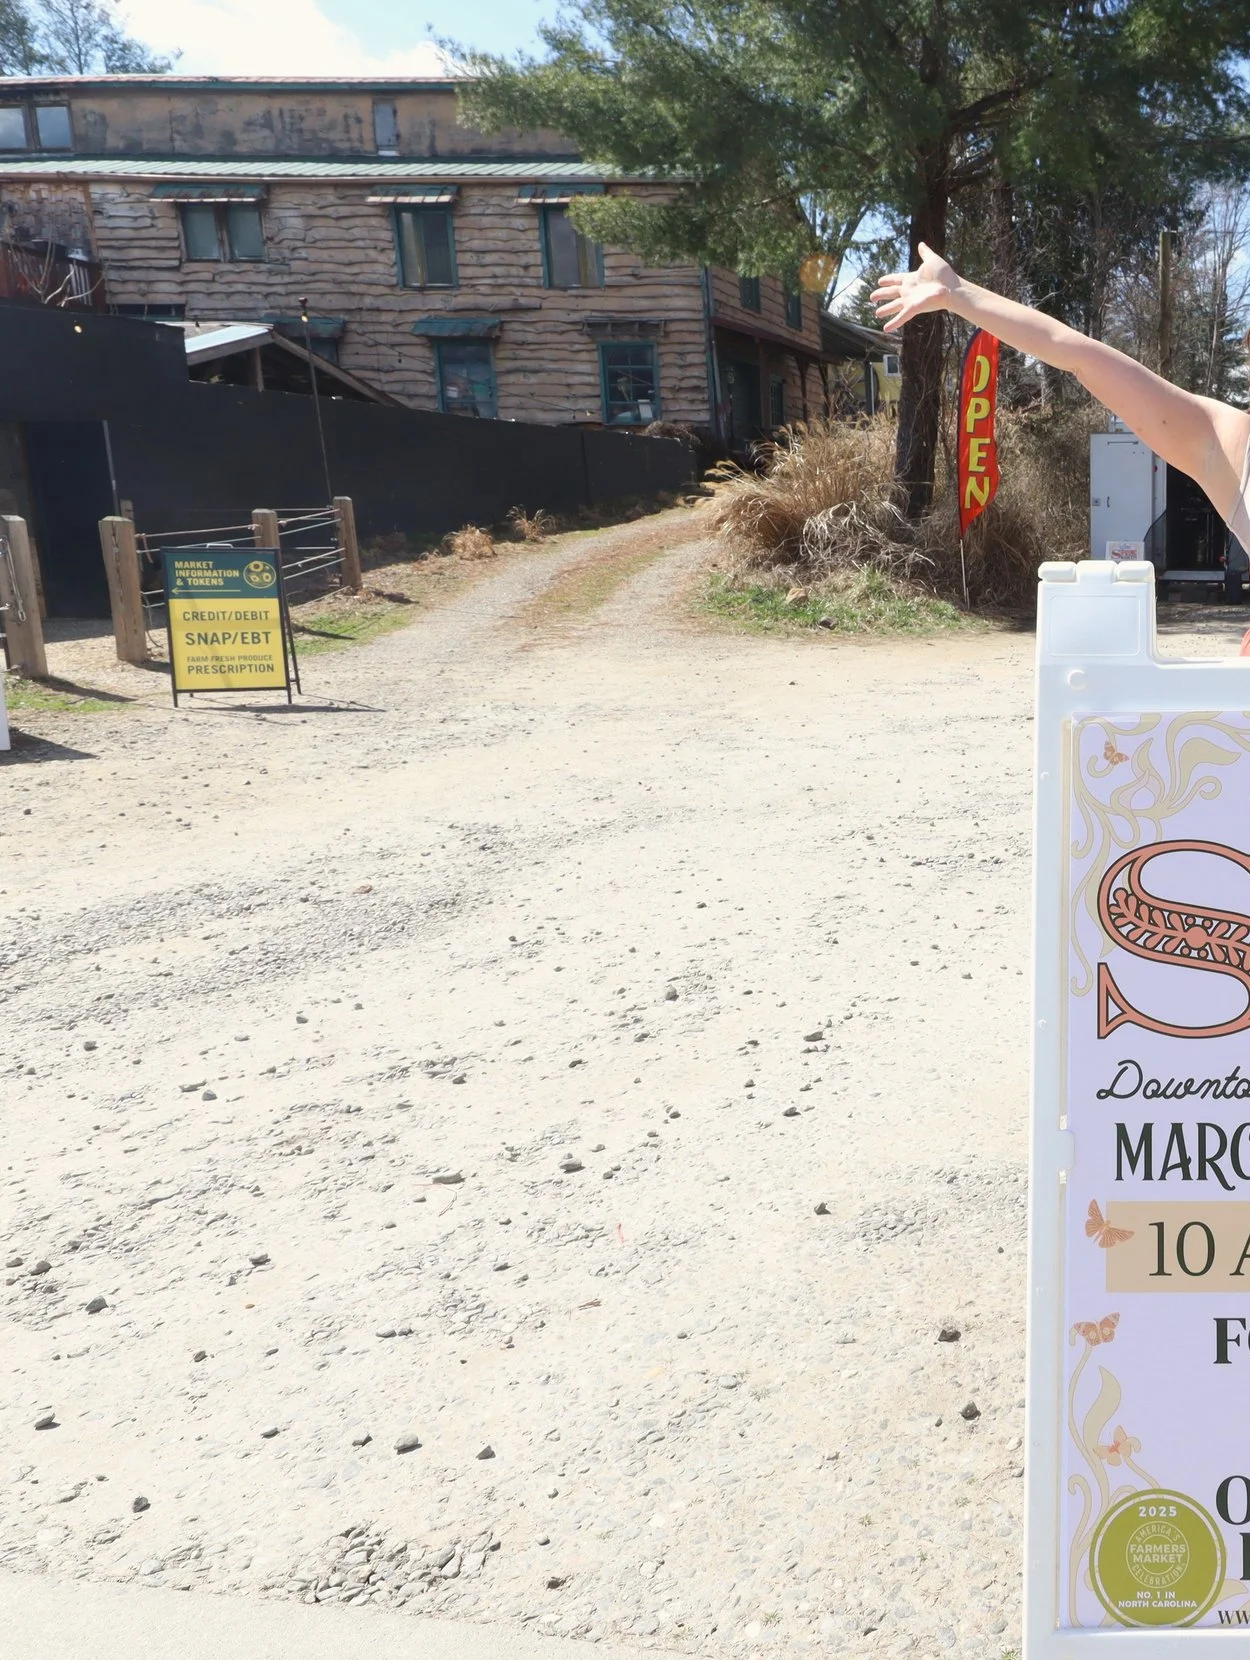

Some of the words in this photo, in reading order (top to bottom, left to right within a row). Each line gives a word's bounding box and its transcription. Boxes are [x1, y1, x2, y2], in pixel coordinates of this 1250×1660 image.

[964, 355, 991, 509] OPEN
[175, 561, 213, 569] MARKET
[175, 569, 239, 577] INFORMATION
[176, 578, 184, 586] &
[188, 578, 224, 586] TOKENS
[183, 611, 269, 621] CREDIT/DEBIT
[185, 631, 271, 646] SNAP/EBT
[238, 654, 273, 662] PRODUCE
[187, 664, 274, 675] PRESCRIPTION
[1149, 1221, 1215, 1277] 10
[1139, 1506, 1177, 1517] 2025
[1136, 1524, 1181, 1542] AMERICA'S
[1130, 1544, 1186, 1553] FARMERS
[1133, 1554, 1183, 1563] MARKET
[1131, 1564, 1184, 1586] CELEBRATION
[1136, 1591, 1152, 1599] NO.
[1156, 1591, 1161, 1599] 1
[1165, 1591, 1176, 1599] IN
